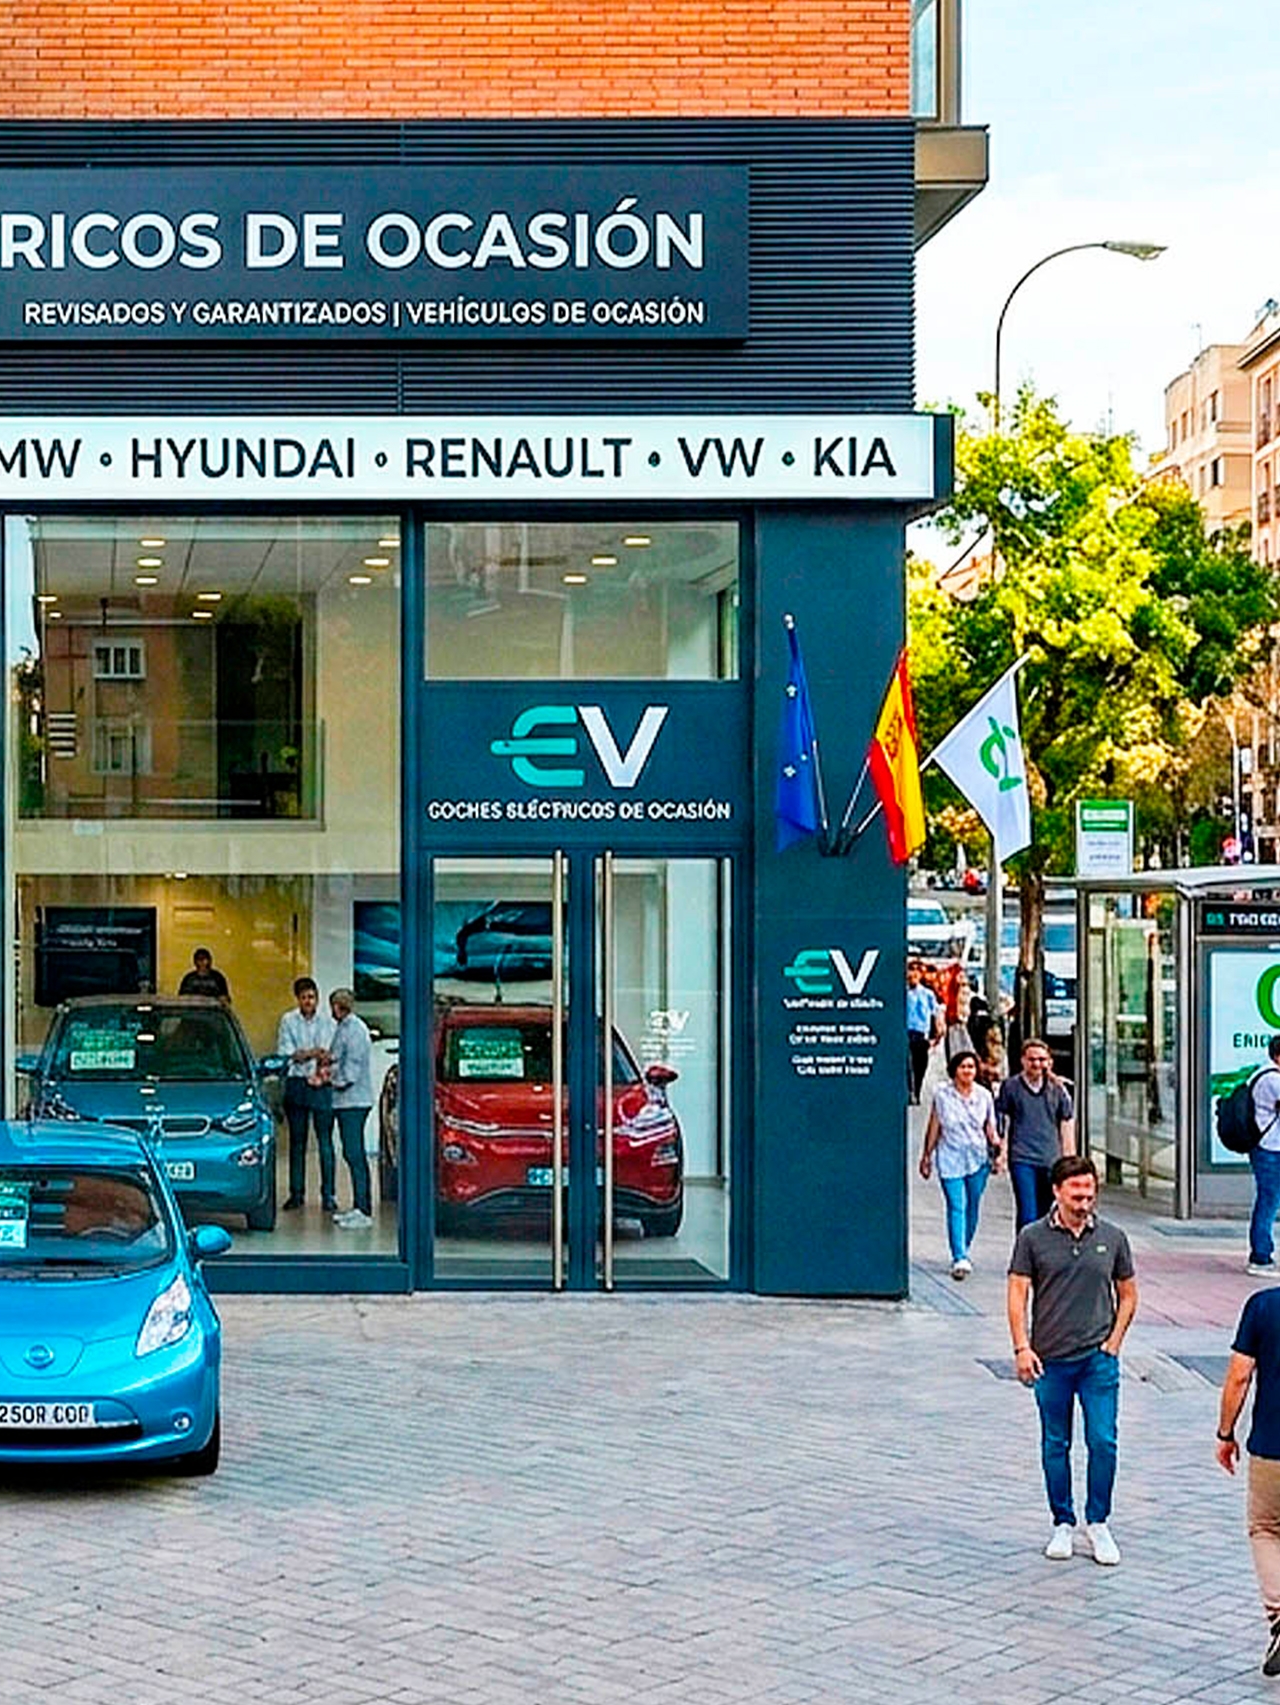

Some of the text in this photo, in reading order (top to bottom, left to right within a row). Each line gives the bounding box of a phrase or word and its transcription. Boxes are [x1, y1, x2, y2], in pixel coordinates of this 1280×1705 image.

[246, 213, 344, 268] DE
[366, 198, 703, 269] OCASIÓN
[25, 295, 704, 325] REVISADOS Y GARANTIZADOS VEHÍCULOS DE OCASIÓN
[131, 437, 355, 479] HYUNDAI
[406, 437, 633, 479] RENAULT
[677, 437, 765, 478] VW
[813, 437, 897, 477] KIA
[490, 705, 669, 788] EV
[783, 949, 880, 995] EV
